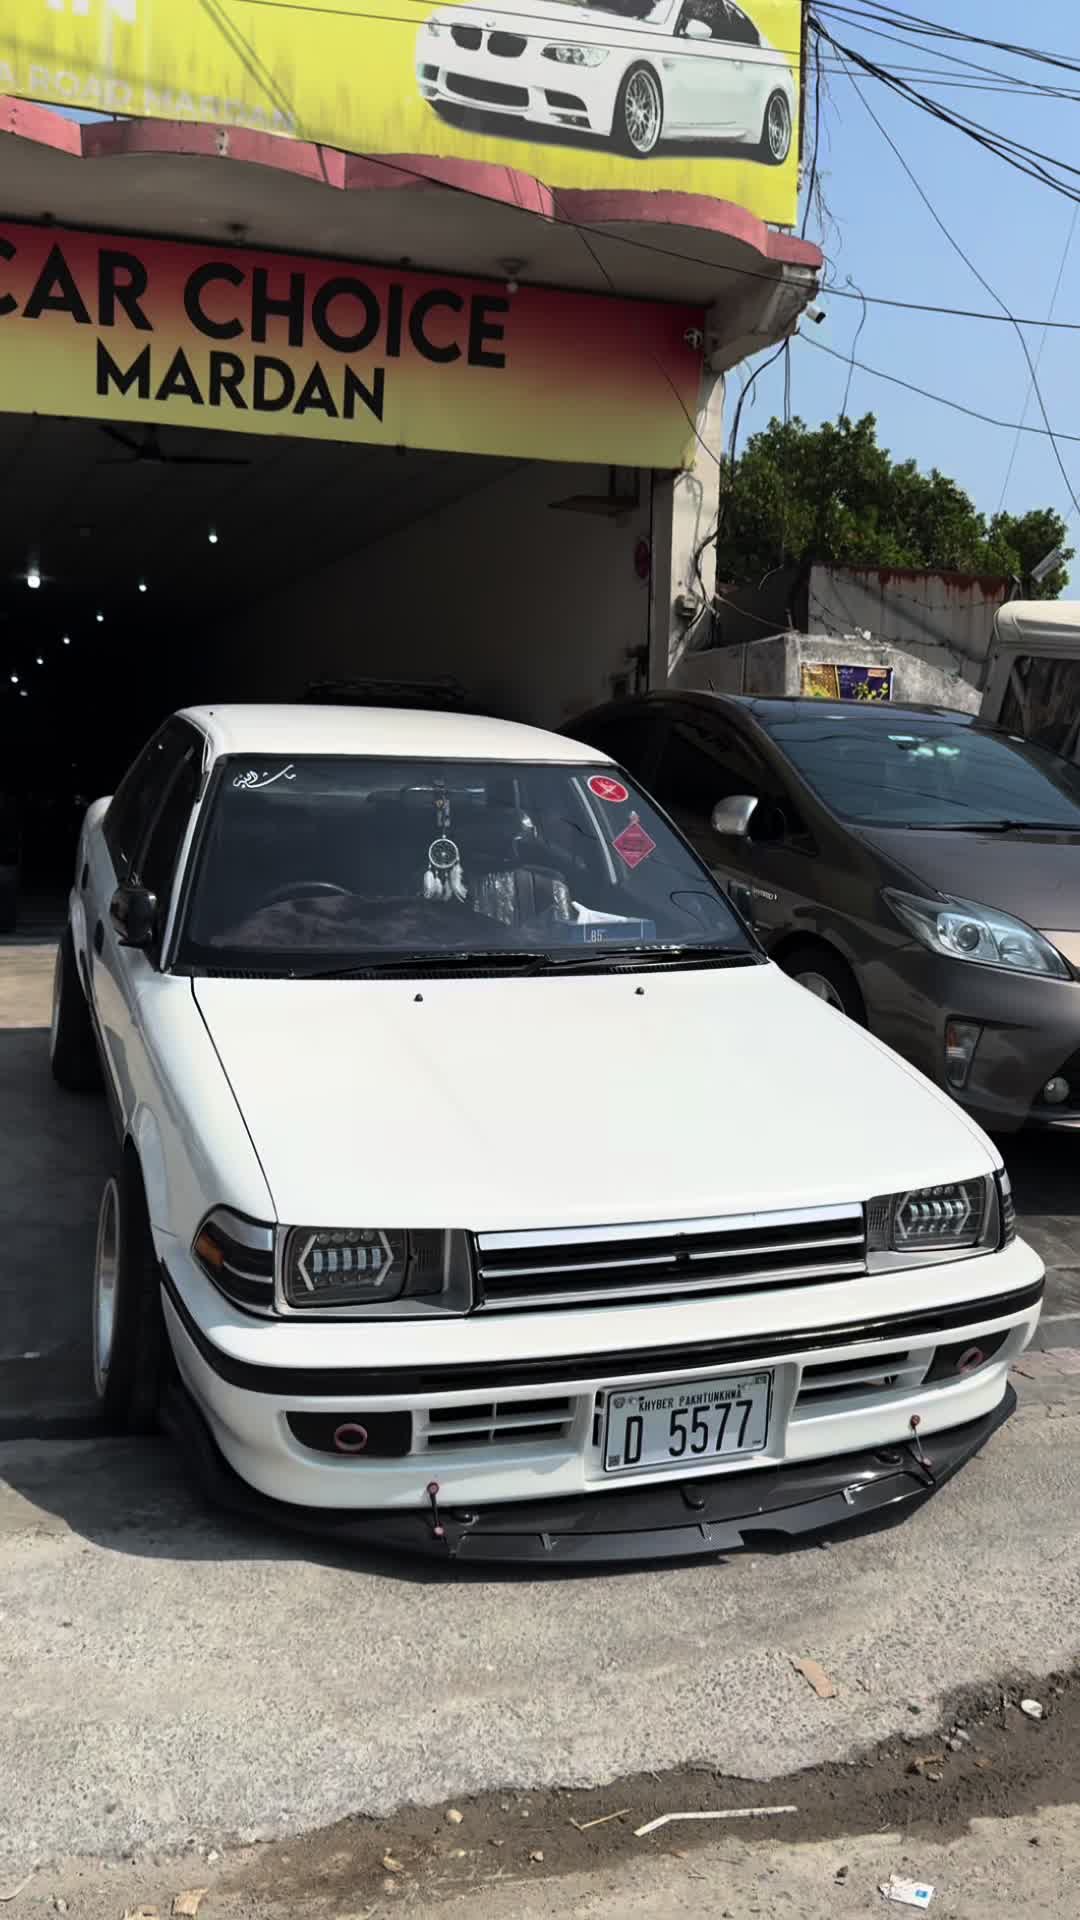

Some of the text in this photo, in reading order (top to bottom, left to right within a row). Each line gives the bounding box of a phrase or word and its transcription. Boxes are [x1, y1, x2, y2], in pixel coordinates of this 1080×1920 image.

[30, 64, 132, 107] ROAD
[184, 261, 511, 368] CHOICE
[97, 336, 385, 422] MARDAN
[639, 1389, 743, 1413] KHYBER PAKHTUNKHWA
[668, 1399, 753, 1457] 5577
